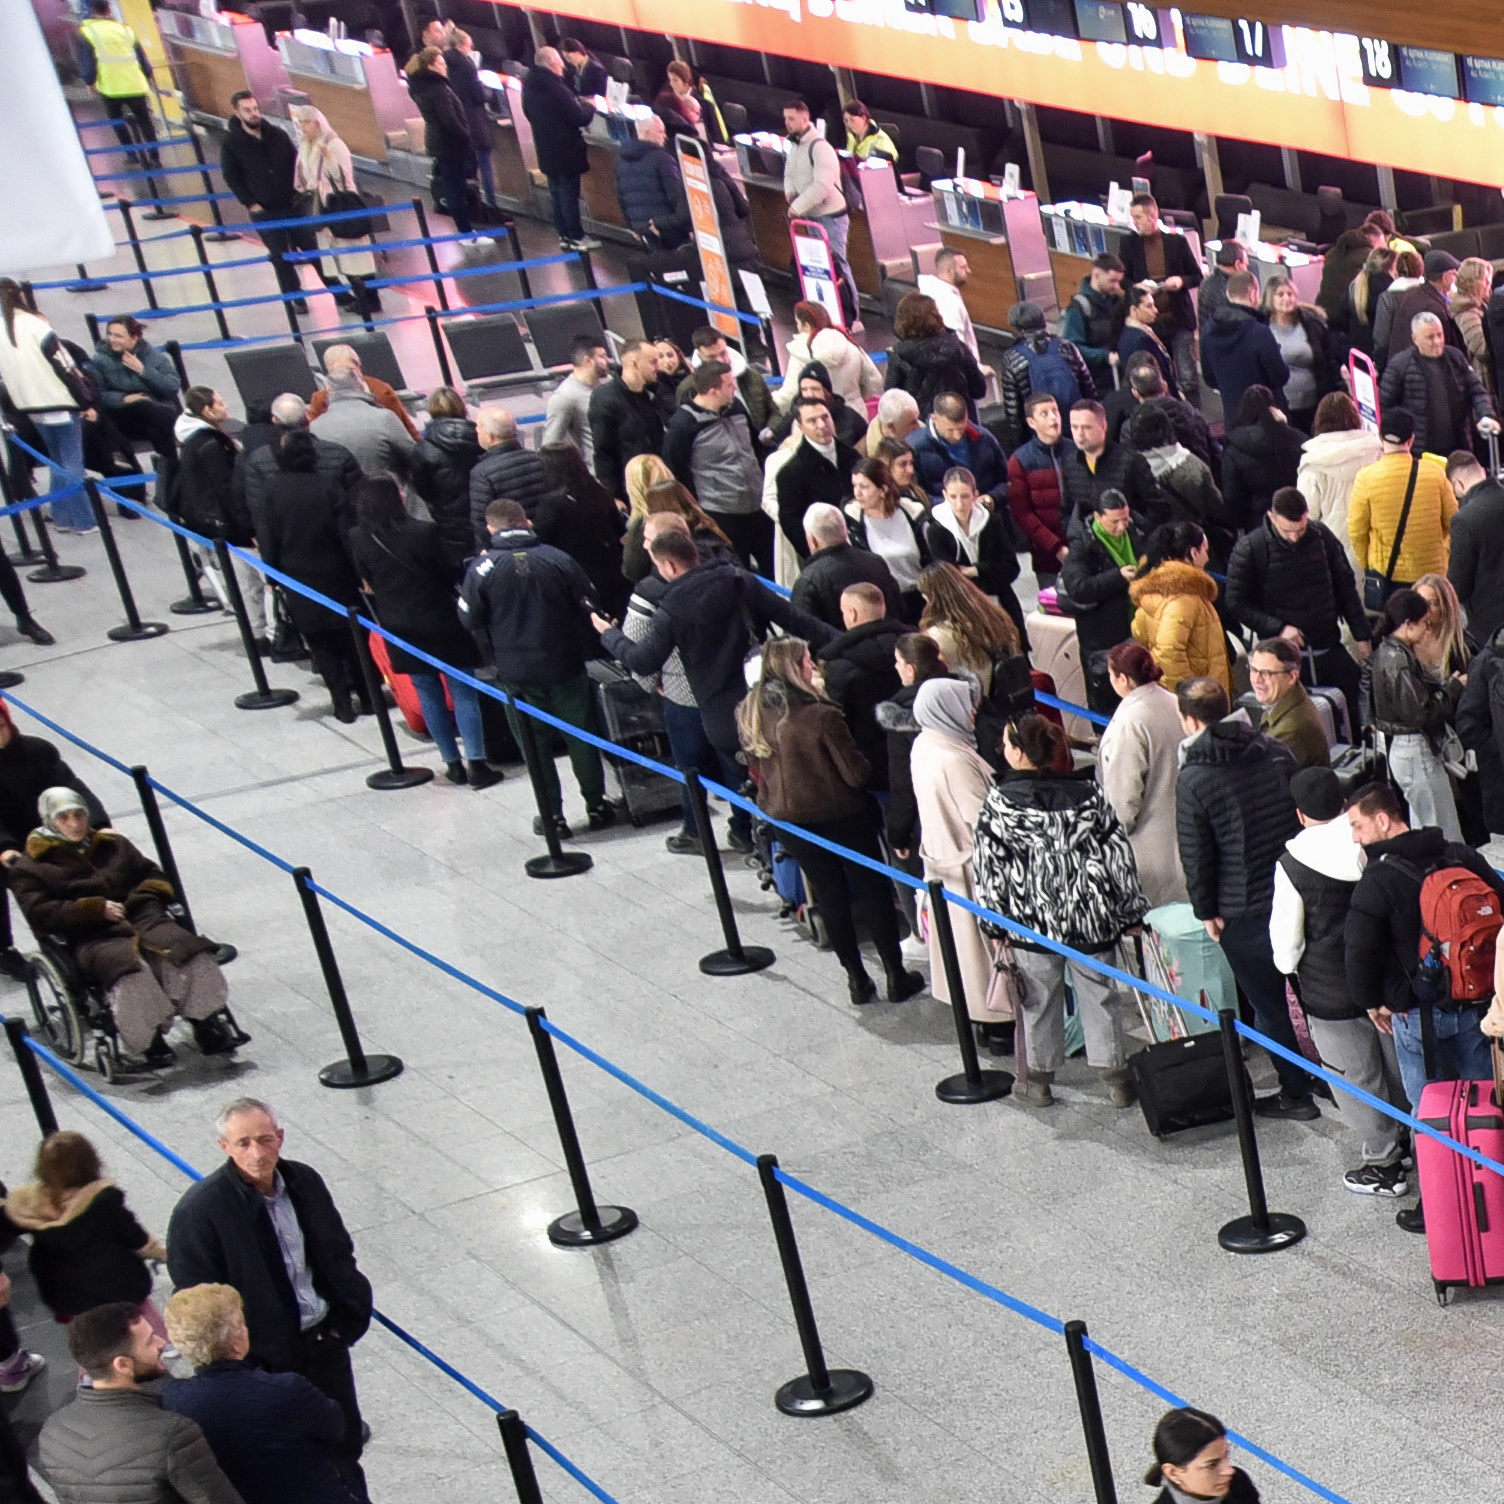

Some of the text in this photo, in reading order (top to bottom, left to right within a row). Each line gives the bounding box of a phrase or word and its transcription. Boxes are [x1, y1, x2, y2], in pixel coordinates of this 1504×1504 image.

[1127, 2, 1156, 39] 16
[1237, 18, 1263, 57] 17
[1362, 38, 1392, 79] 18
